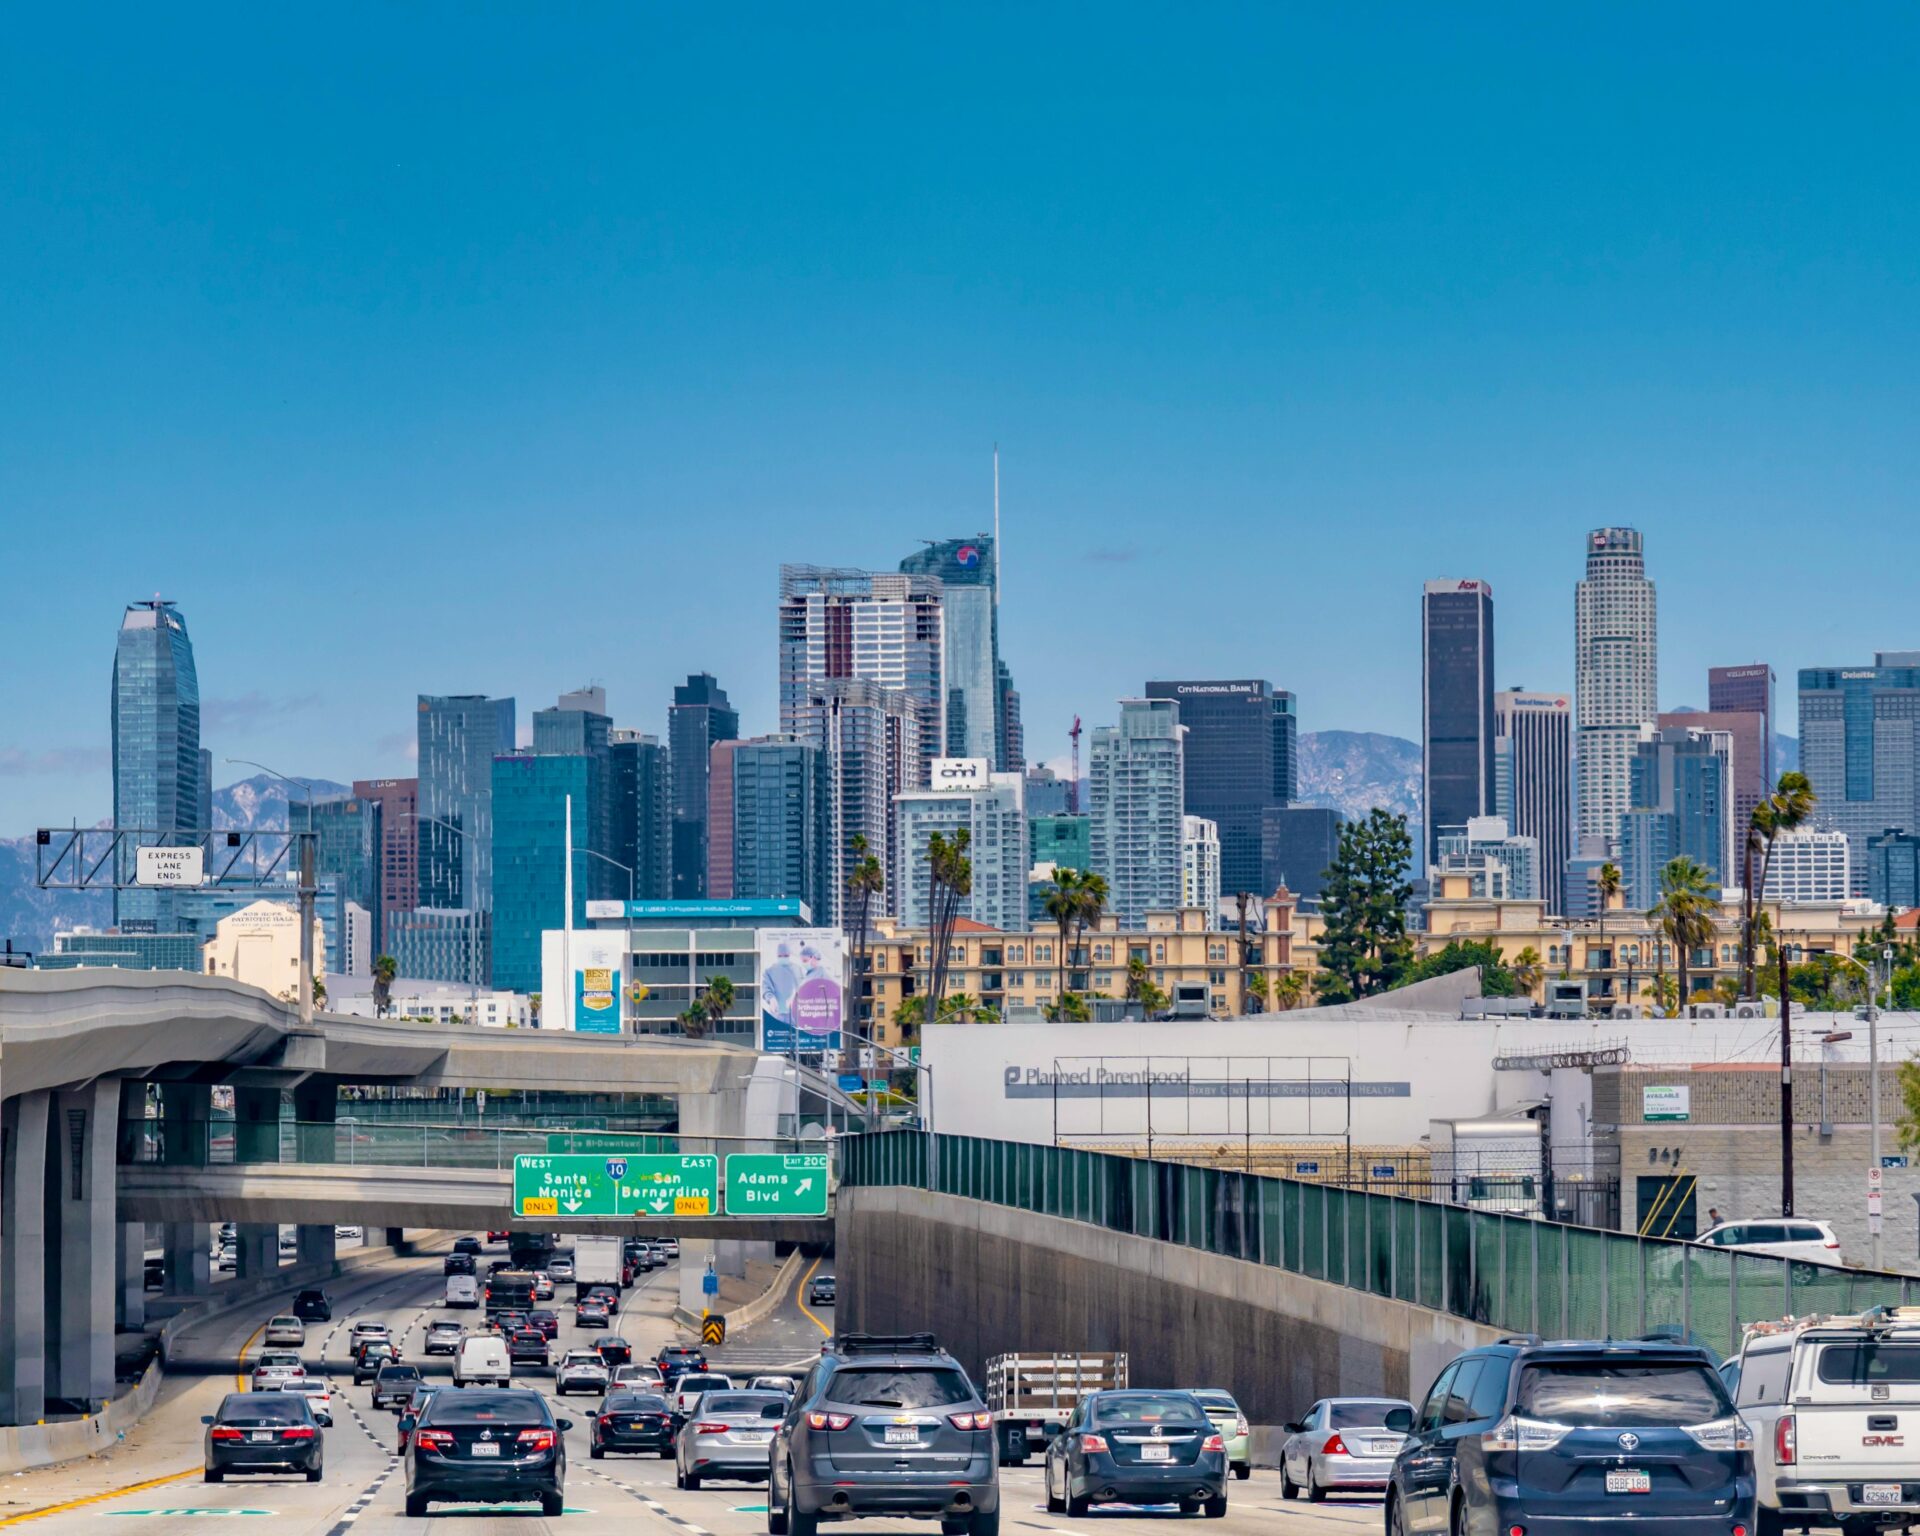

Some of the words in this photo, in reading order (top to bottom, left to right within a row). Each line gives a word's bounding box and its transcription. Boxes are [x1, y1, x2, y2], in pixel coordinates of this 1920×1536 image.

[1842, 671, 1876, 679] Deloitte
[1793, 835, 1840, 843] WILSHIRE
[585, 969, 611, 978] BEST
[1026, 1066, 1091, 1086] Planned
[520, 1157, 552, 1168] WEST
[611, 1164, 624, 1175] 10
[681, 1157, 712, 1168] EAST
[803, 1157, 827, 1166] 20C
[544, 1172, 587, 1184] Santa
[653, 1172, 681, 1184] San
[738, 1172, 788, 1184] Adams
[538, 1186, 592, 1198] Monica
[621, 1186, 710, 1198] Bernardino
[746, 1189, 780, 1202] Blvd
[525, 1202, 554, 1211] ONLY
[676, 1201, 706, 1210] ONLY
[1009, 1430, 1022, 1445] R
[1862, 1436, 1904, 1447] GMC
